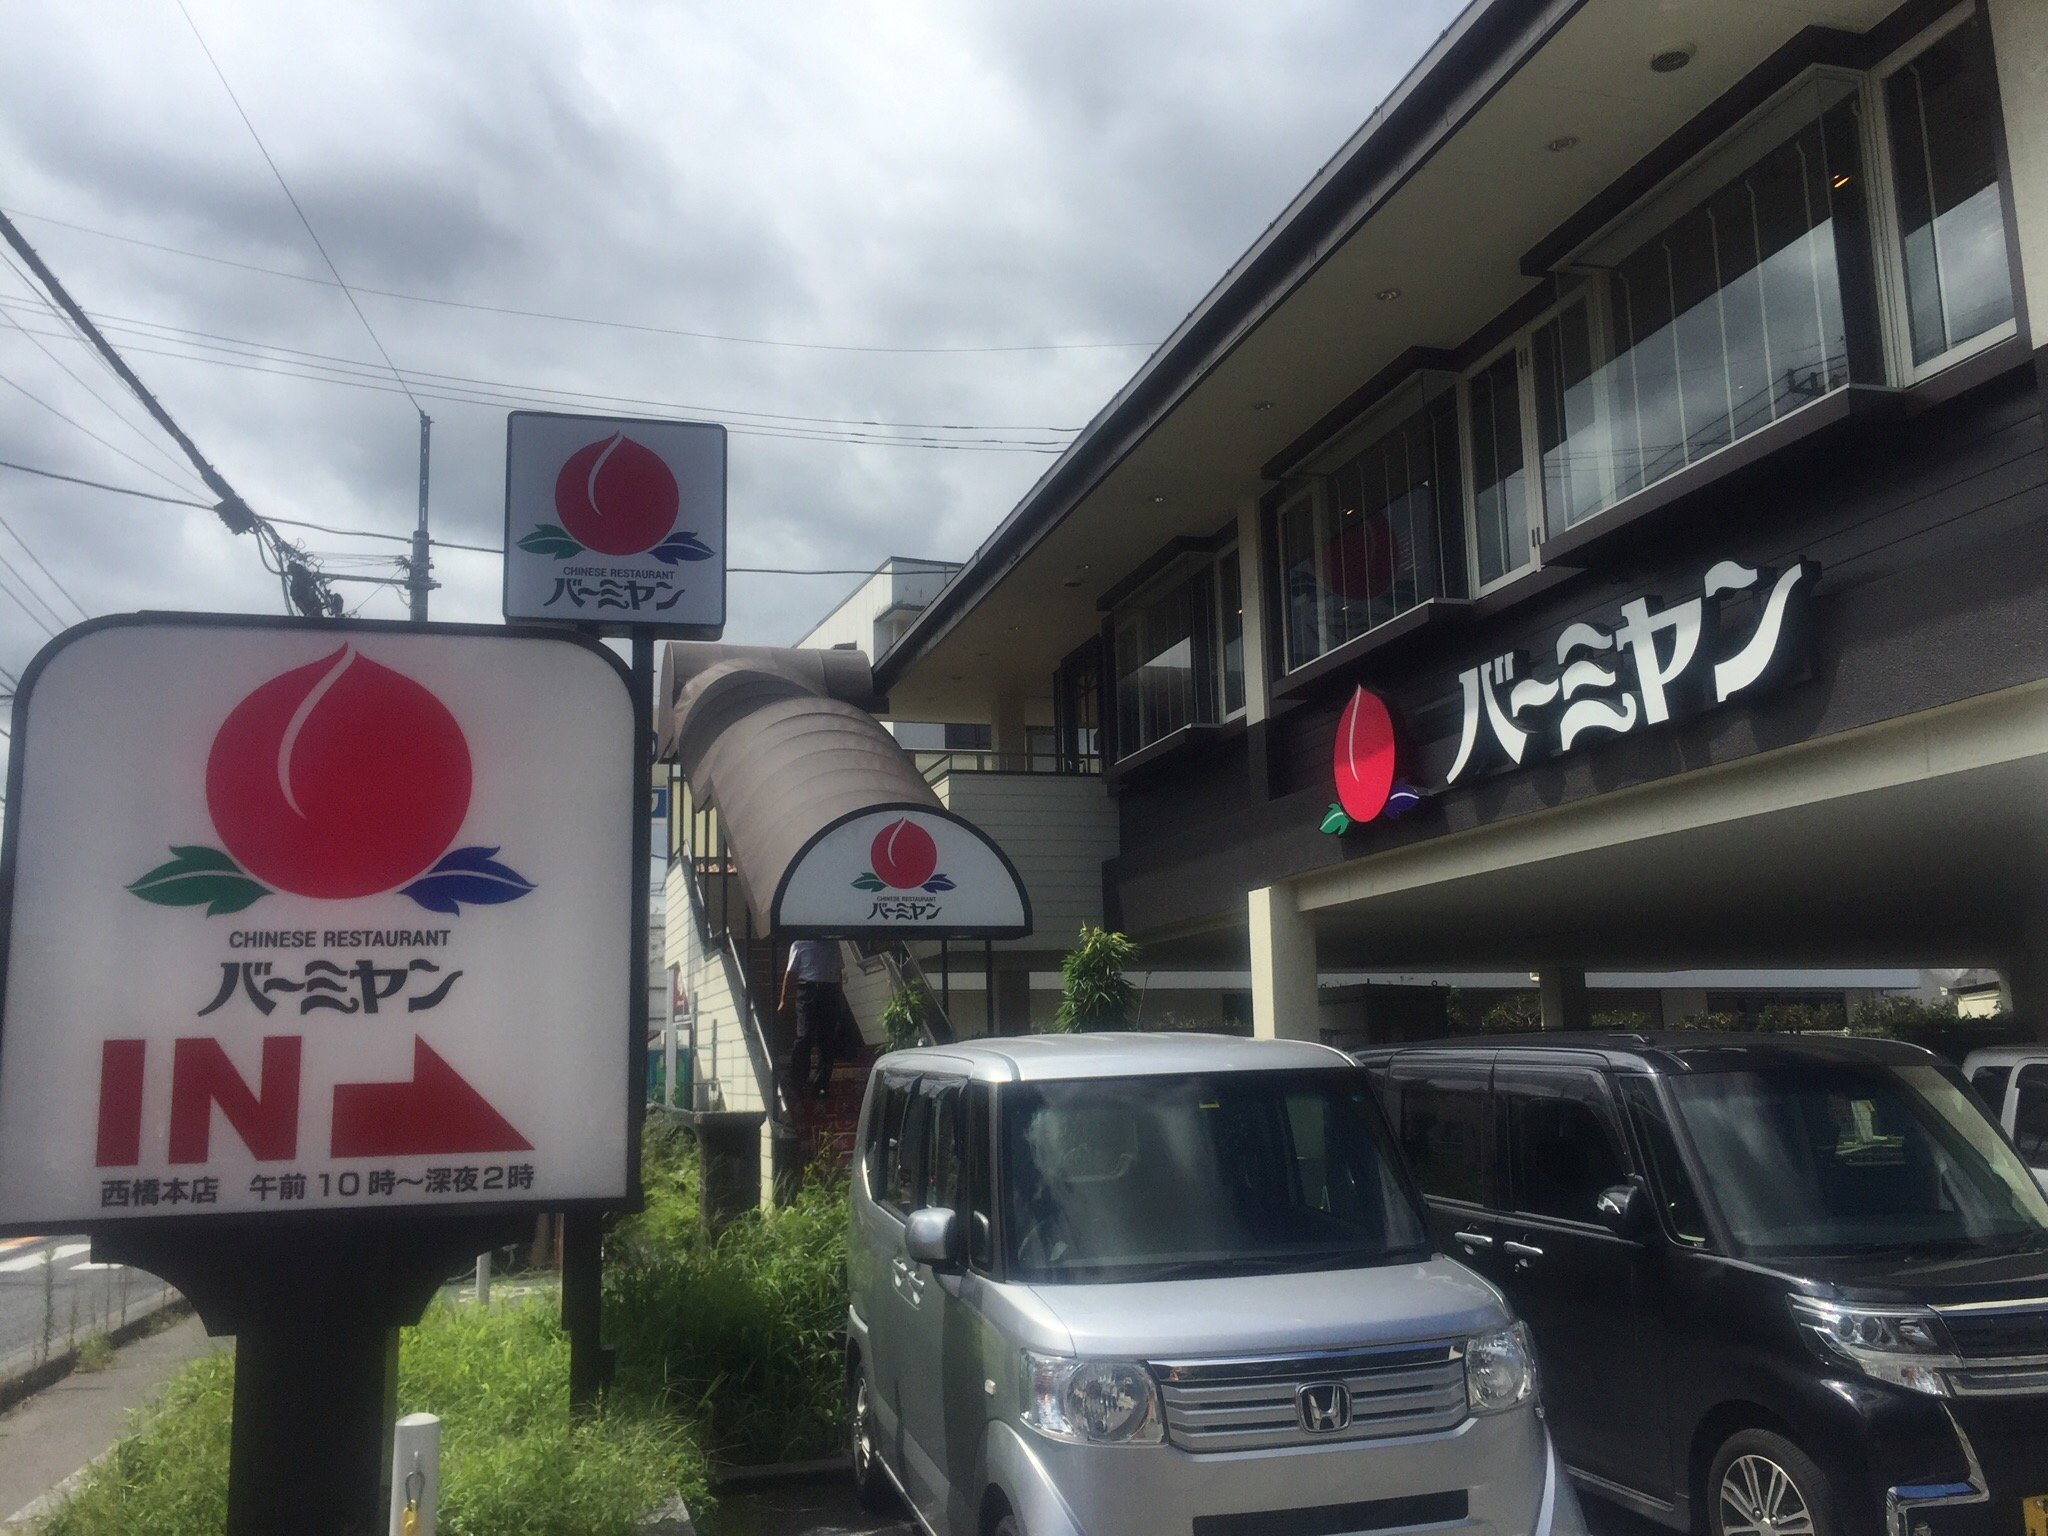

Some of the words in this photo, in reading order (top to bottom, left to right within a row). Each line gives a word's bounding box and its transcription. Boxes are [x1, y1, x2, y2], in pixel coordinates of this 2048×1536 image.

[563, 567, 607, 577] CHINESE
[610, 568, 676, 580] RESTAURANT
[543, 577, 686, 611] バーミヤン
[1445, 560, 1802, 785] バーミヤン
[867, 902, 942, 920] バーミヤン
[229, 930, 317, 948] CHINESE
[323, 929, 451, 948] RESTAURANT
[197, 958, 463, 1017] バーミヤン
[96, 1035, 302, 1168] IN
[101, 1175, 219, 1208] 西橋本店
